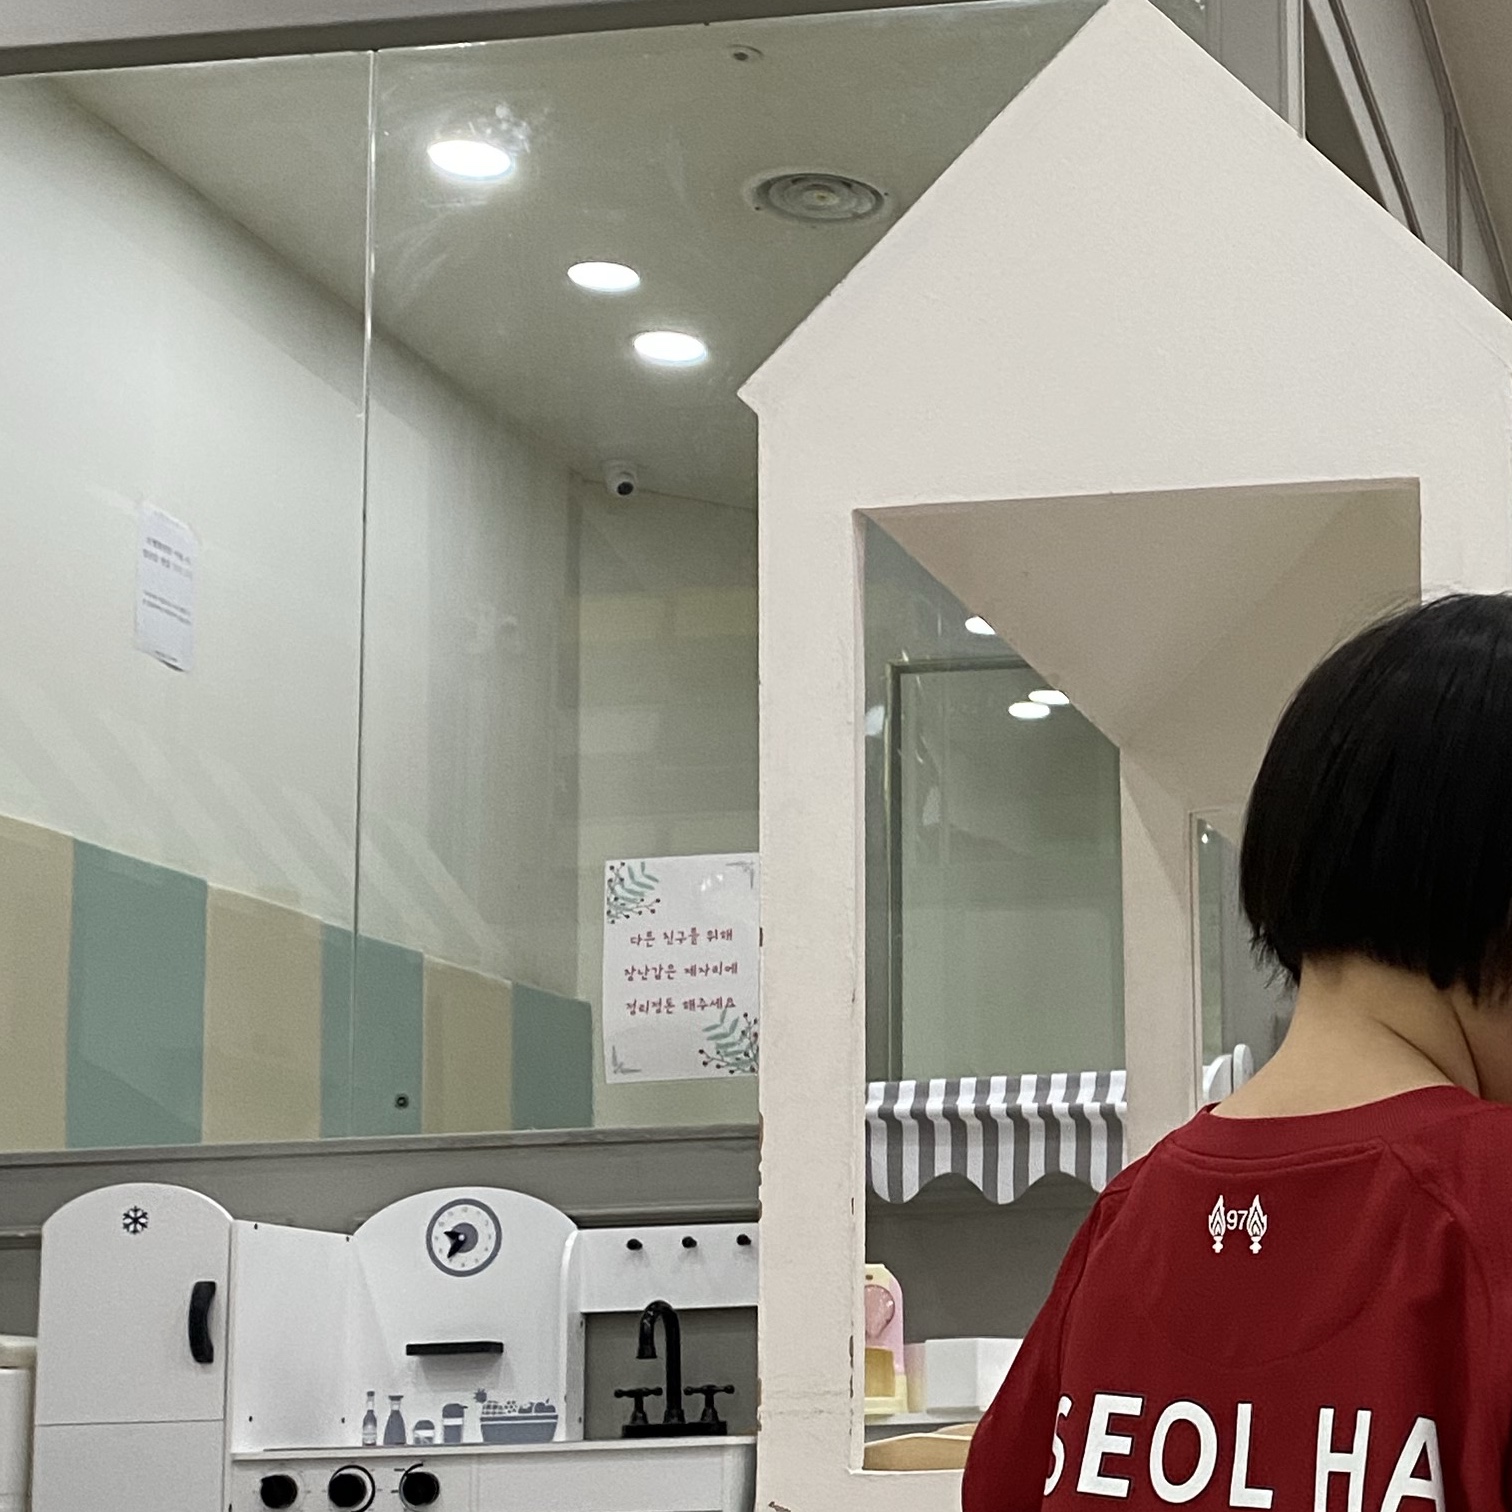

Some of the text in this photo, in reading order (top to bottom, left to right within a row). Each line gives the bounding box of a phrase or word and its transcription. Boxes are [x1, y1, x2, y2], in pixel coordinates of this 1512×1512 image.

[707, 928, 733, 942] 위해
[624, 963, 677, 981] 장난감은
[626, 996, 737, 1016] 정리정돈 해주세요
[1226, 1209, 1249, 1231] 97
